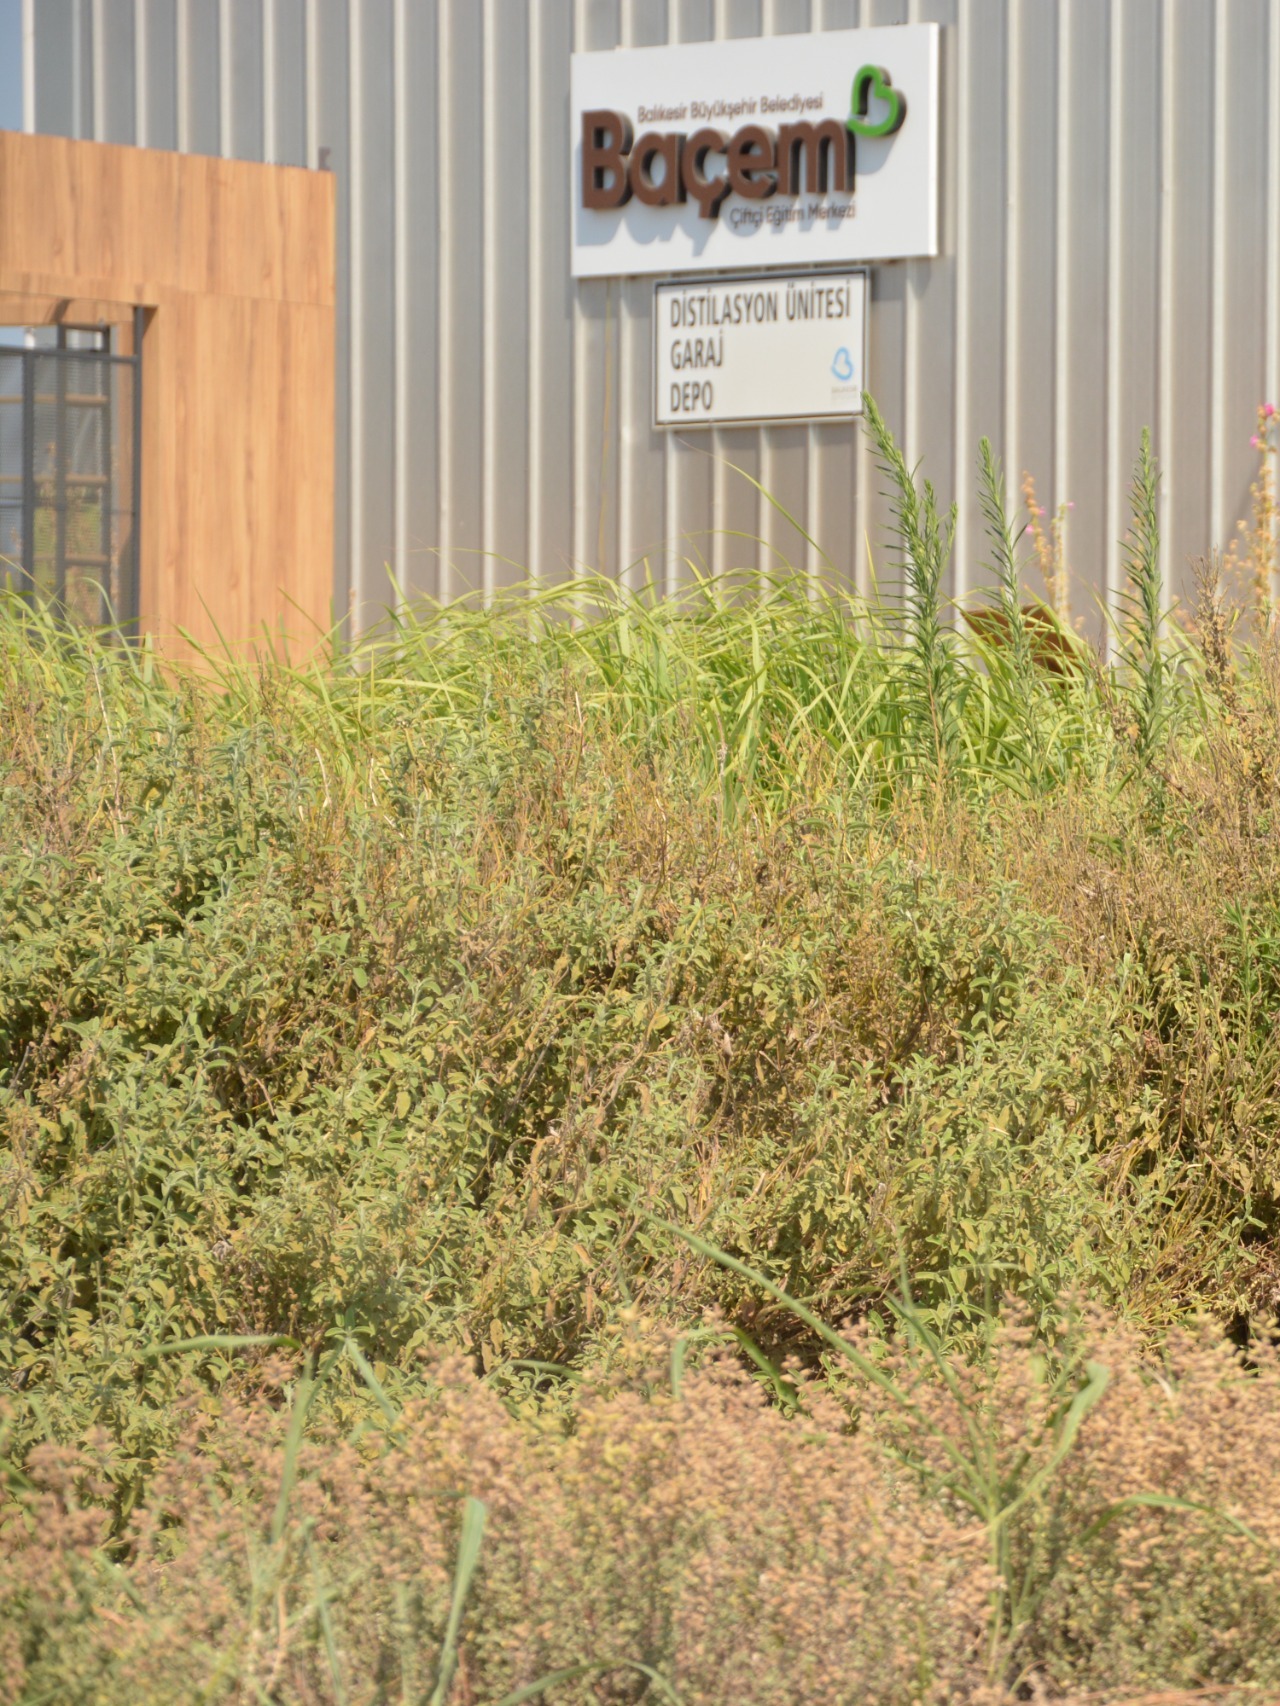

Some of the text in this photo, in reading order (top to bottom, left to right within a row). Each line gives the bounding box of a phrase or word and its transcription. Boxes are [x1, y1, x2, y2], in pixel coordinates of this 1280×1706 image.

[690, 97, 757, 120] Büyükşehir
[760, 92, 823, 113] Belediyesi
[582, 109, 856, 218] Baçem
[730, 199, 857, 229] Çiftçi Eğitim Merkezi
[670, 278, 851, 327] DİSTİLASYON ÜNİTESİ
[670, 380, 714, 412] DEPO
